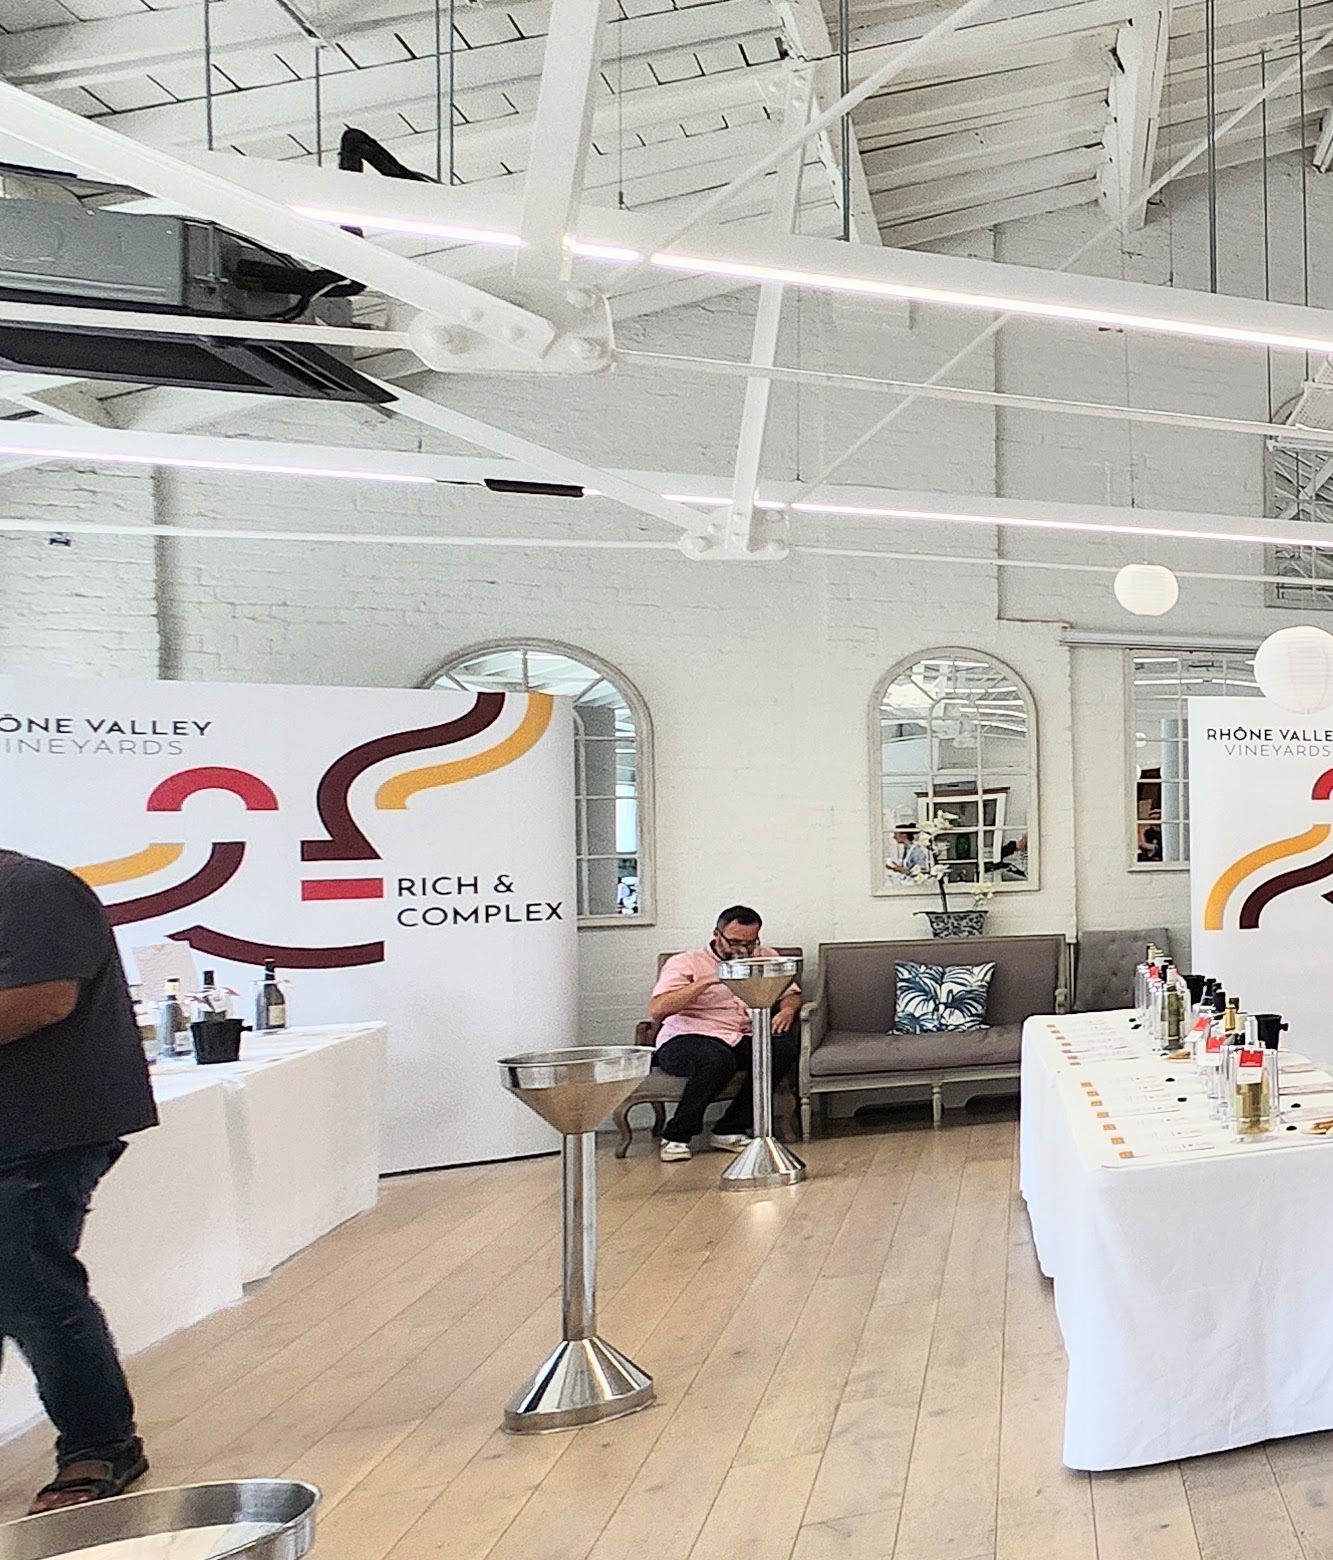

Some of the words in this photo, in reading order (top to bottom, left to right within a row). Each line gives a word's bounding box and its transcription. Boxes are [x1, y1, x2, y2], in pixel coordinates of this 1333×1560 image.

[85, 718, 213, 736] VALLEY
[1206, 726, 1274, 741] RHÔNE
[1224, 744, 1331, 757] VINEYARDS
[398, 875, 479, 897] RICH
[493, 874, 514, 894] &
[396, 902, 564, 927] COMPLEX
